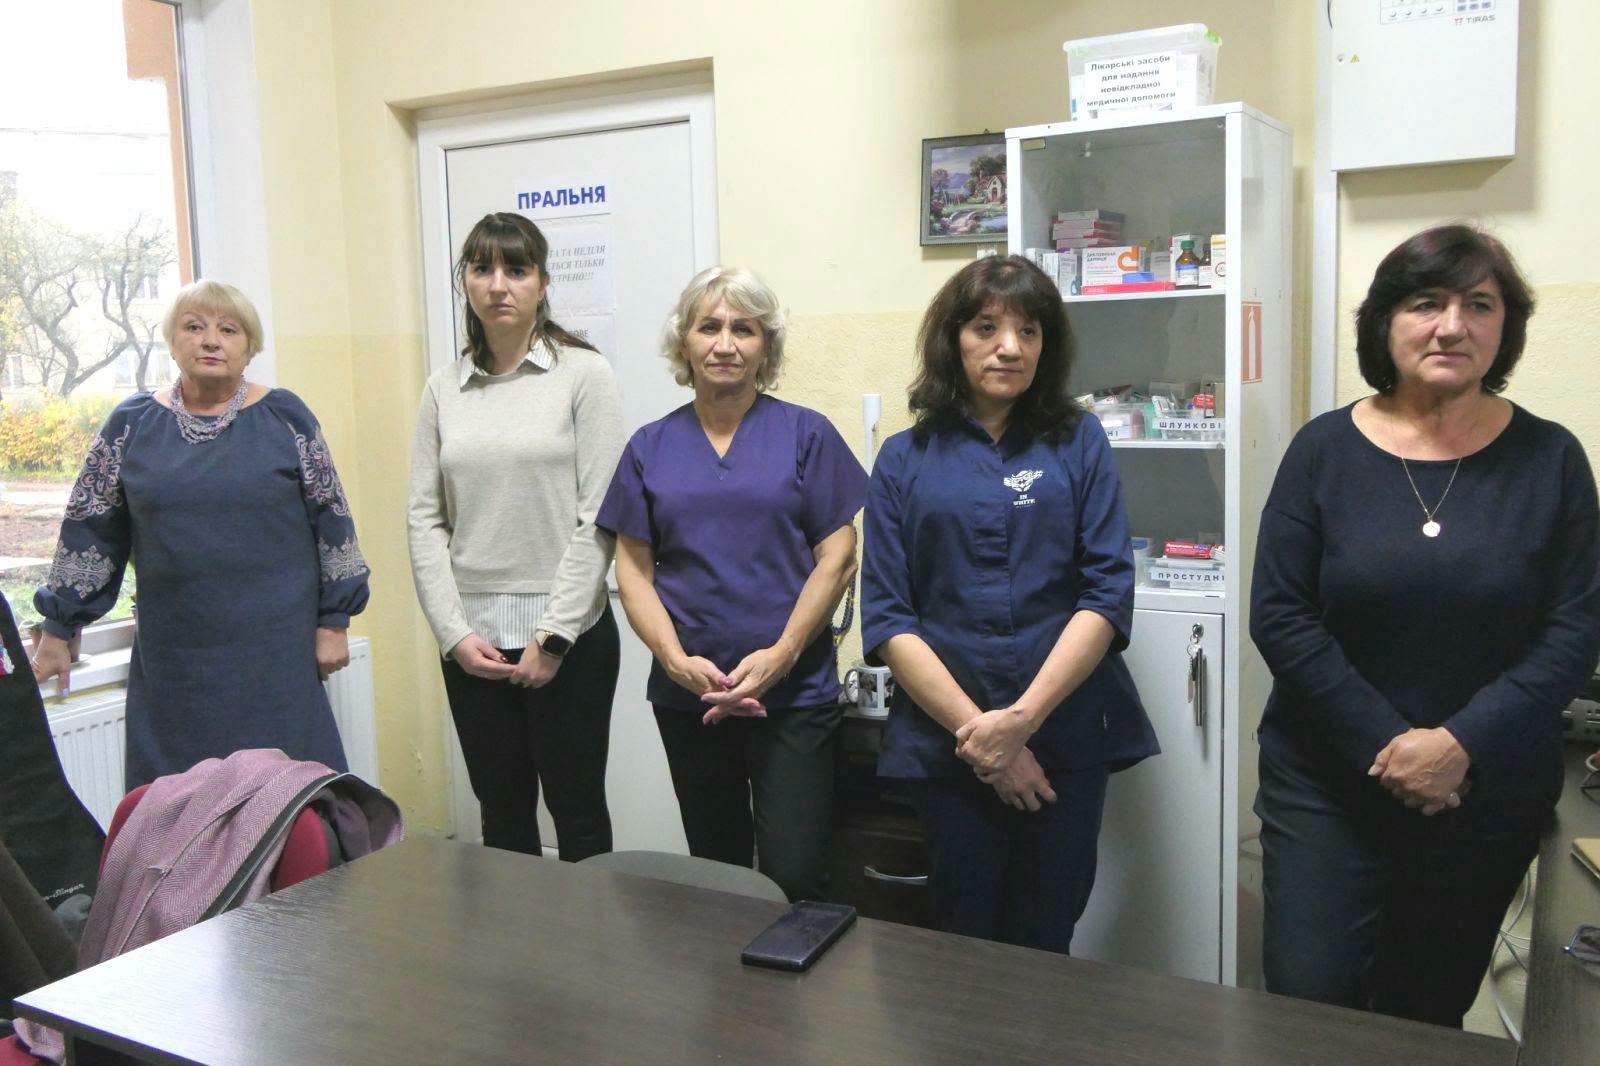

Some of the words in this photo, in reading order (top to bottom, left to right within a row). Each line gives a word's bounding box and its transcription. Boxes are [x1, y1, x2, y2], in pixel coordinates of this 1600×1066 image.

[1466, 14, 1496, 24] TIRAS
[1090, 59, 1134, 72] Лікарські
[1137, 55, 1171, 65] засоби
[1101, 74, 1118, 83] для
[1120, 69, 1160, 79] надання
[1086, 97, 1129, 107] медичної
[1131, 91, 1176, 103] допомоги
[518, 185, 606, 210] ПРАЛЬНЯ
[560, 248, 571, 258] ТА
[573, 245, 606, 256] НЕДІЛЯ
[574, 258, 605, 269] ТІЛЬКИ
[552, 272, 594, 283] СТРЕНО!!!
[1159, 421, 1221, 430] ШЛУНКОВІ
